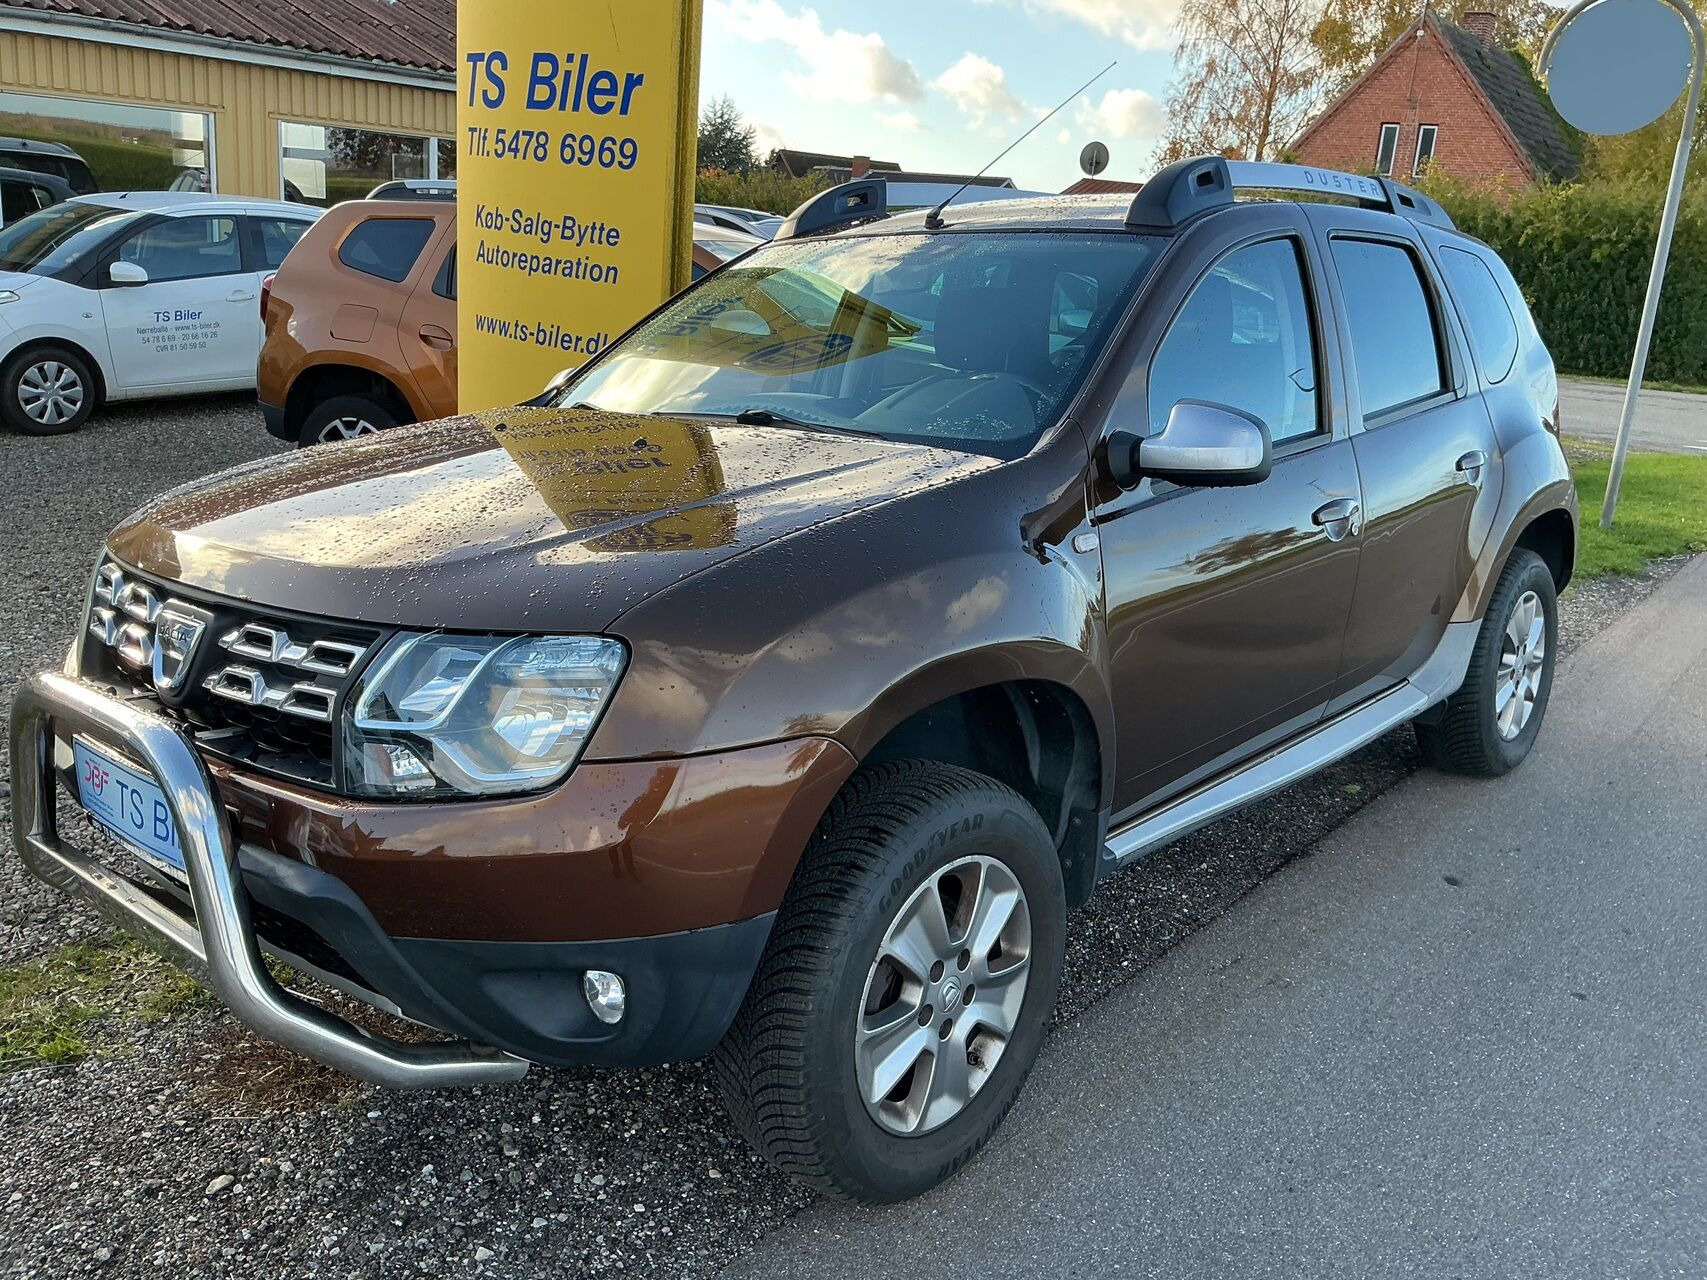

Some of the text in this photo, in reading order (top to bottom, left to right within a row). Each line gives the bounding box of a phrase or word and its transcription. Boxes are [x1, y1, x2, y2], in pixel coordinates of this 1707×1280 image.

[466, 50, 645, 116] TS Biler
[559, 133, 638, 170] 6969
[1303, 170, 1380, 196] DUSTER
[475, 204, 620, 248] Køb-Salg-Bytte
[475, 240, 619, 285] Autoreparation
[154, 310, 202, 322] TS Biler
[174, 321, 221, 332] www.ts-biler.dk
[170, 344, 177, 352] 81
[199, 341, 207, 349] 50
[182, 333, 190, 341] 20
[115, 779, 145, 830] TS
[878, 813, 985, 914] GOODYEAR
